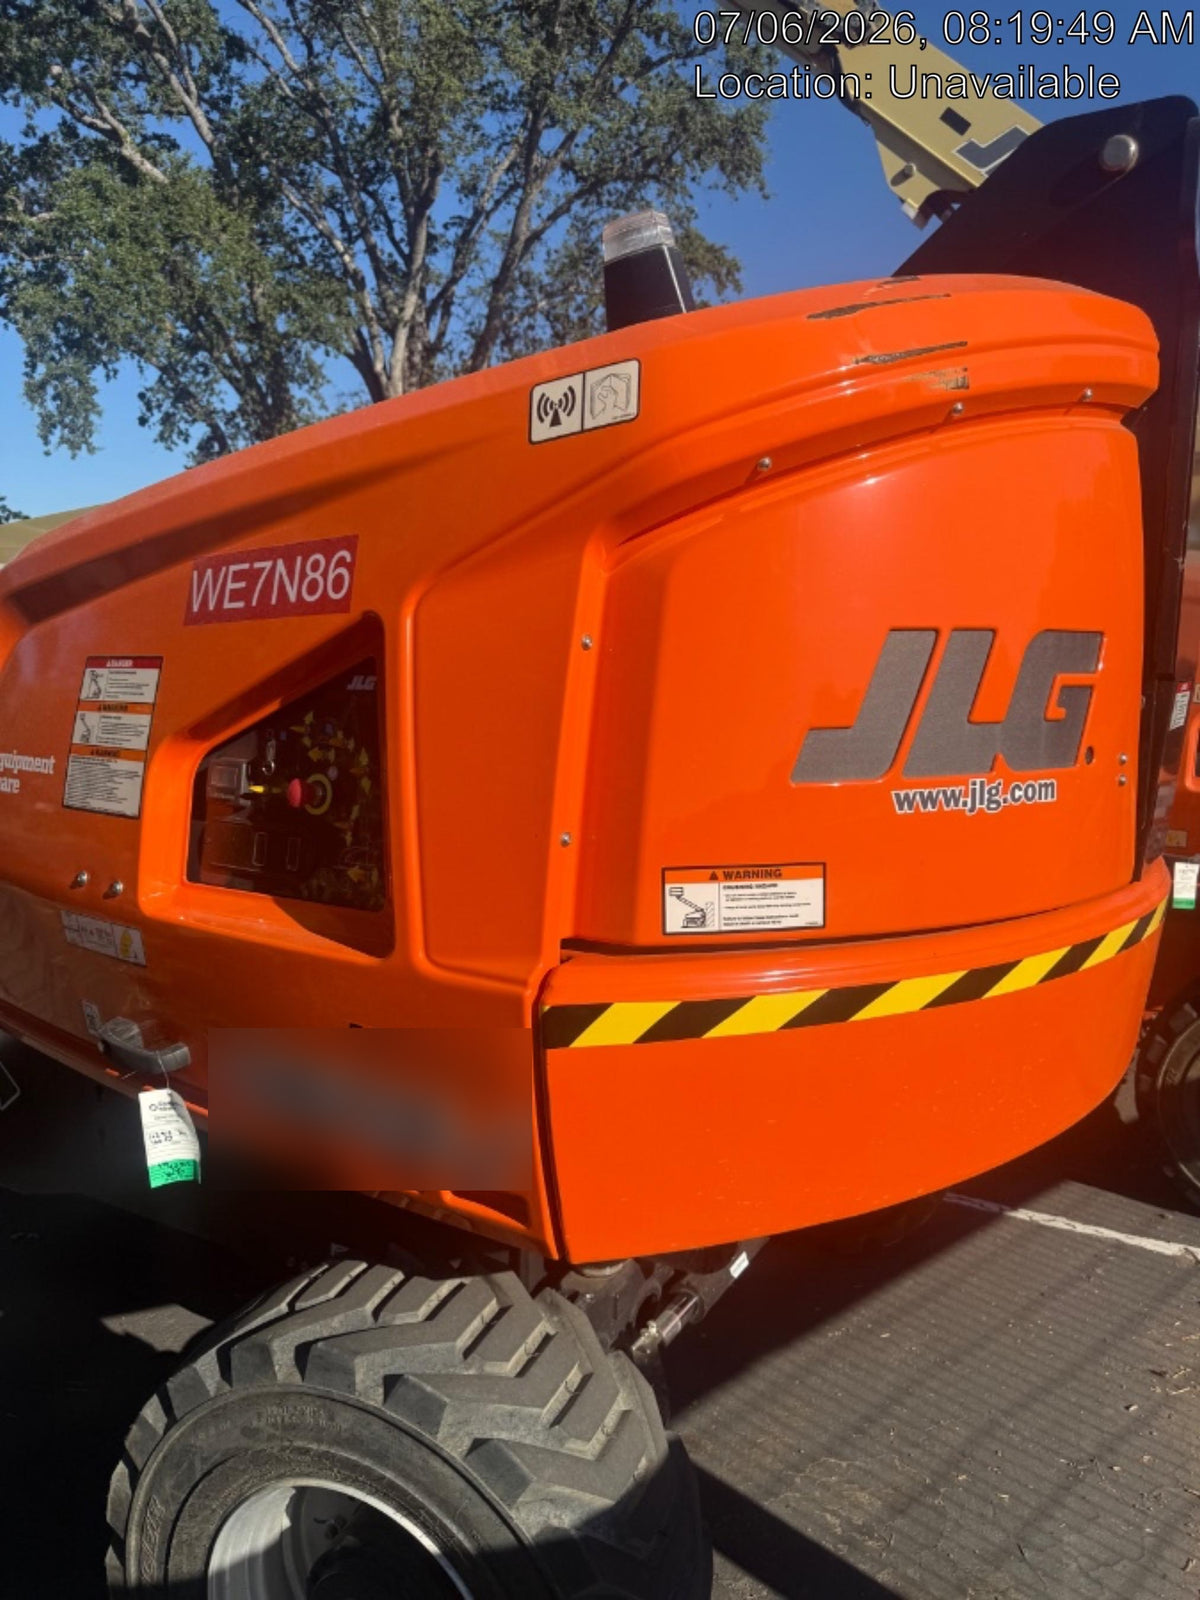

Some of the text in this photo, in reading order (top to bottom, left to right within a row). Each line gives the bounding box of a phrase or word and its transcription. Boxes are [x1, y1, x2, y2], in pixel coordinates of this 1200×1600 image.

[192, 549, 352, 613] WE7N86
[790, 628, 1105, 785] JLG
[893, 778, 1056, 815] www.jlg.com
[722, 868, 783, 881] WARNING
